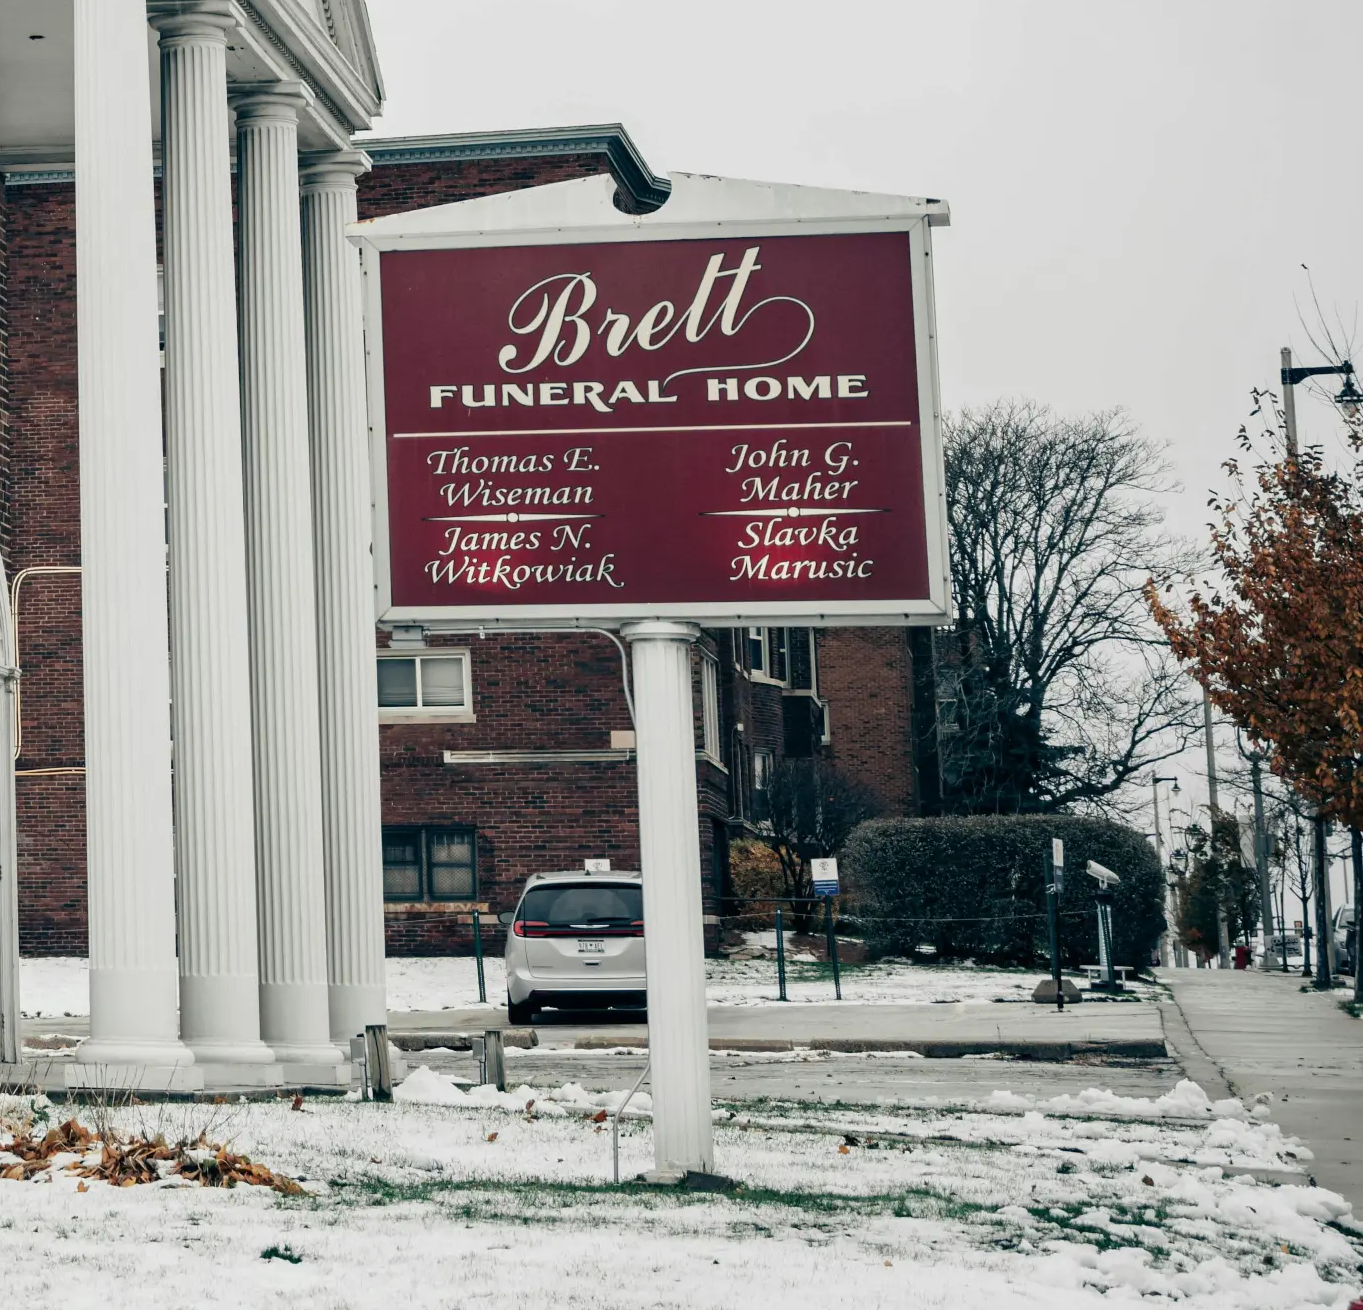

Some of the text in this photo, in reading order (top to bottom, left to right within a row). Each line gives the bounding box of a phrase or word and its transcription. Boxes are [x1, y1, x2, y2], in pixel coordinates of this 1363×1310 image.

[497, 245, 815, 376] Brett
[429, 374, 869, 413] FUNERAL HOME
[426, 446, 600, 475] Thomas E.
[725, 440, 859, 474] John G.
[439, 479, 594, 507] Wiseman
[740, 471, 859, 502] Maher
[438, 523, 591, 556] James N.
[737, 518, 859, 550] Slavka
[424, 552, 625, 589] Witkowiak
[729, 552, 874, 581] Marusic
